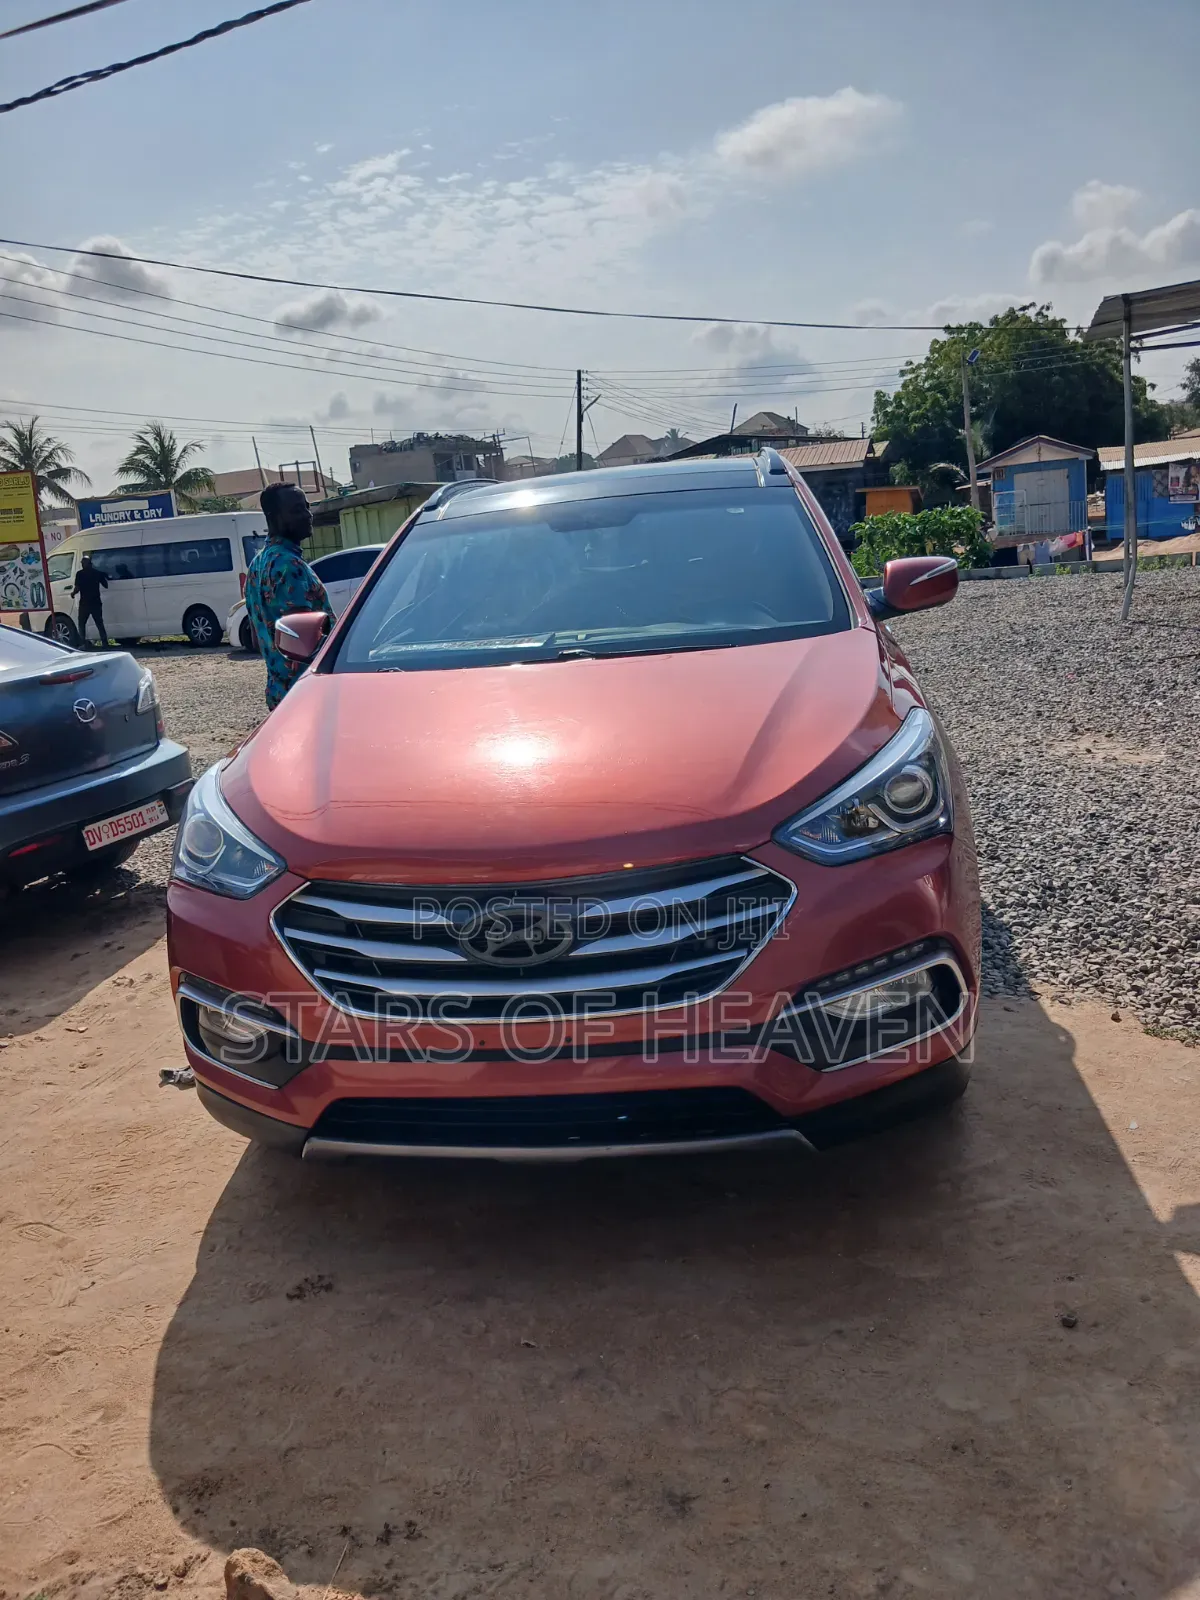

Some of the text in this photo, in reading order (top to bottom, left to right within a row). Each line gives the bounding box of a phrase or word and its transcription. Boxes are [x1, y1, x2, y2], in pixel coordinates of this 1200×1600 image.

[89, 508, 163, 522] LAUNDRY & DRY
